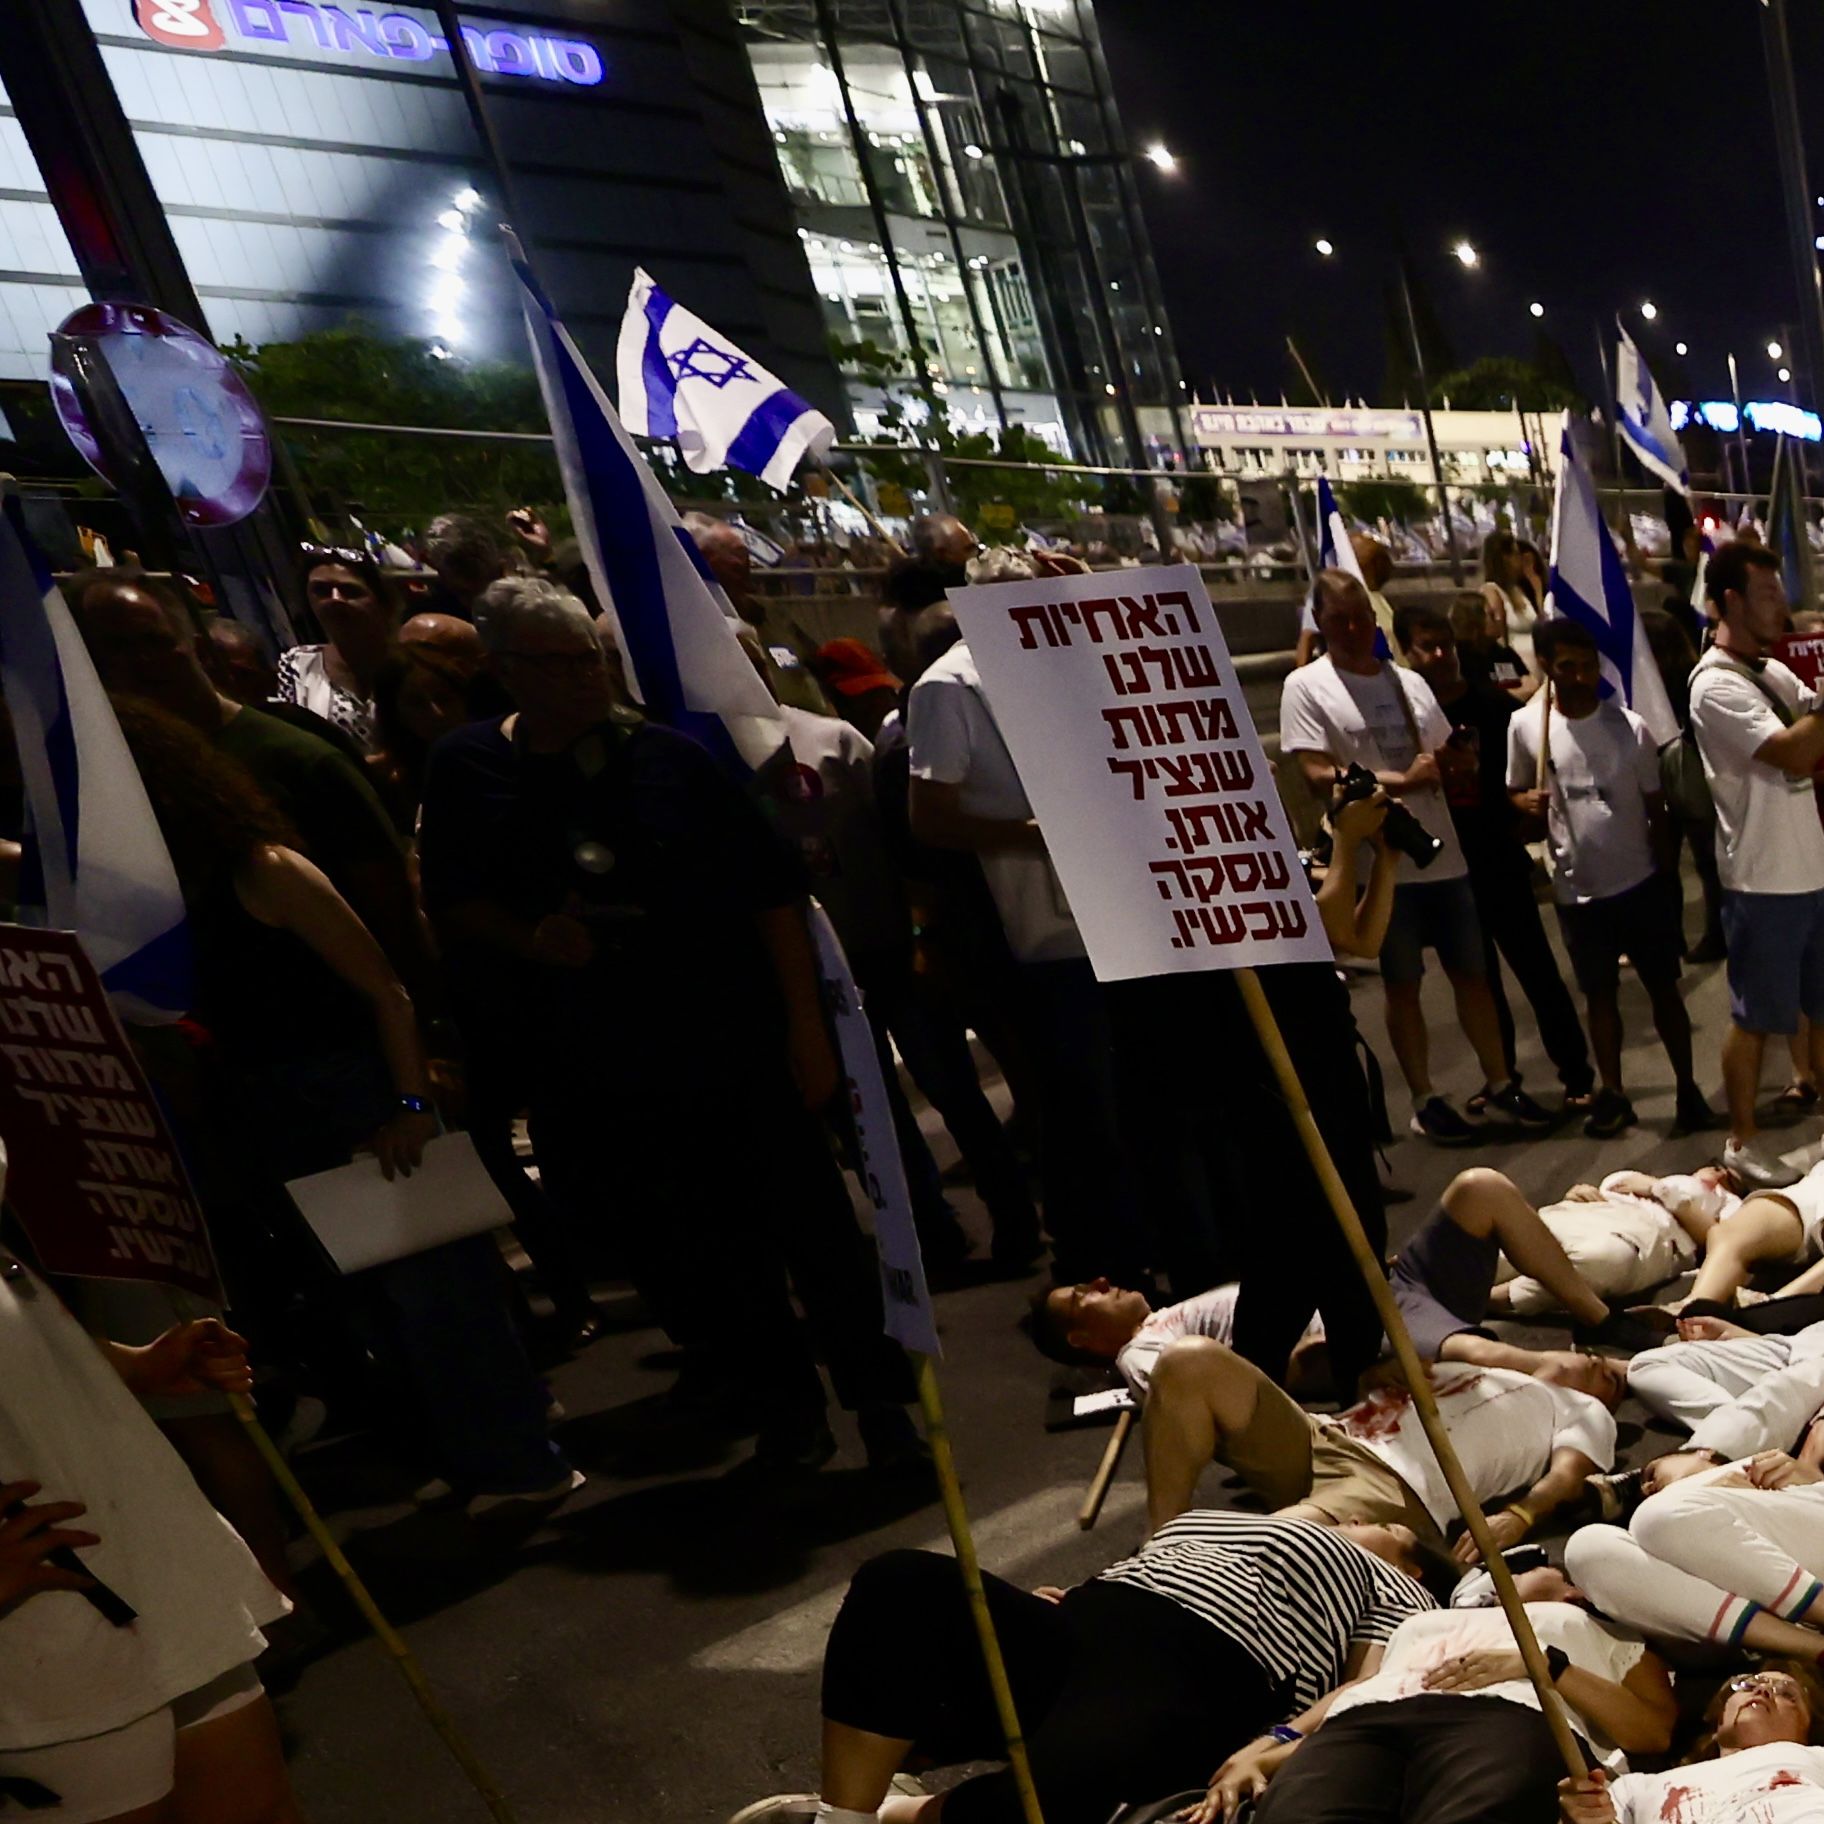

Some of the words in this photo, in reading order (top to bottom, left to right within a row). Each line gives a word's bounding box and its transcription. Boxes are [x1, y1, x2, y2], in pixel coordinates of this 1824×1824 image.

[1008, 591, 1201, 650] האחיות
[1103, 645, 1220, 695] שלנו
[1101, 698, 1239, 749] מתות
[1107, 750, 1254, 800] שנציל
[1164, 801, 1275, 855] אותן.
[1149, 851, 1290, 903] עסקה
[1171, 900, 1308, 949] עכשיו.
[14, 1083, 156, 1138] שנציל
